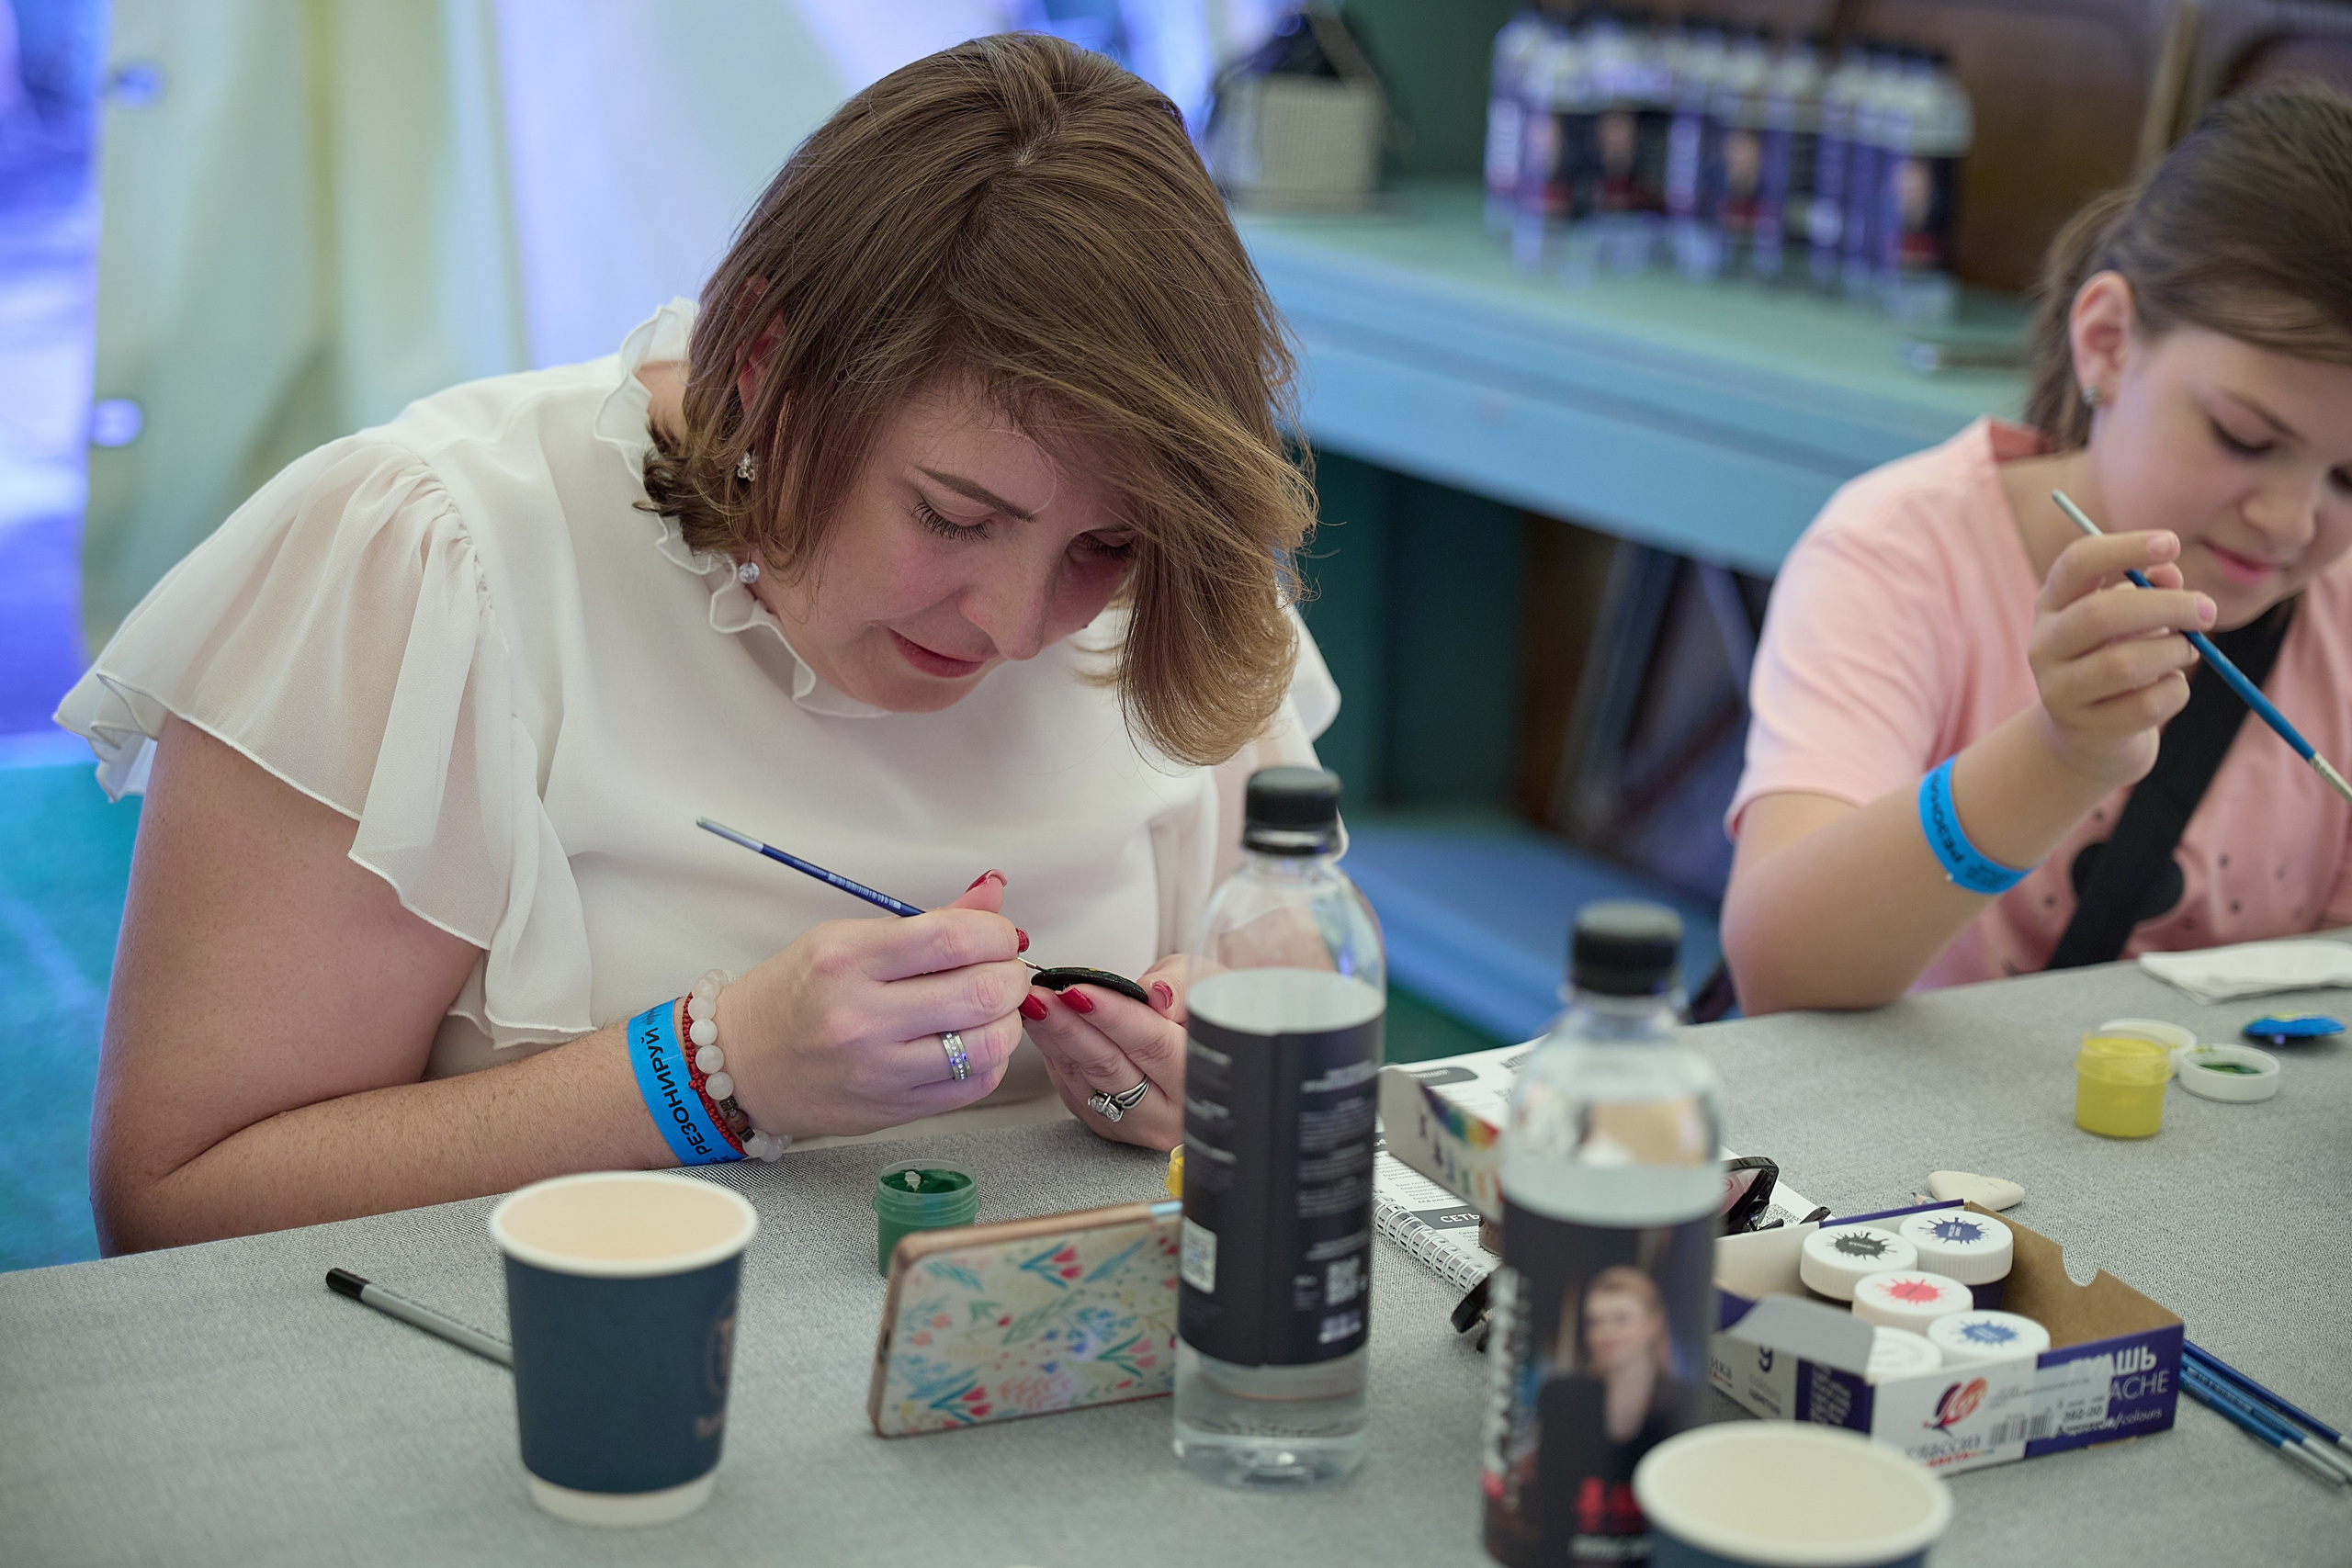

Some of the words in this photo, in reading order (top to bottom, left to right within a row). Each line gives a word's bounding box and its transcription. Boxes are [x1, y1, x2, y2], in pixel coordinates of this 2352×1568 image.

[641, 1027, 713, 1156] РЕЗОНИРУЙ
[1440, 1213, 1480, 1224] СЕТЬ
[2108, 1369, 2170, 1402] ACHE
